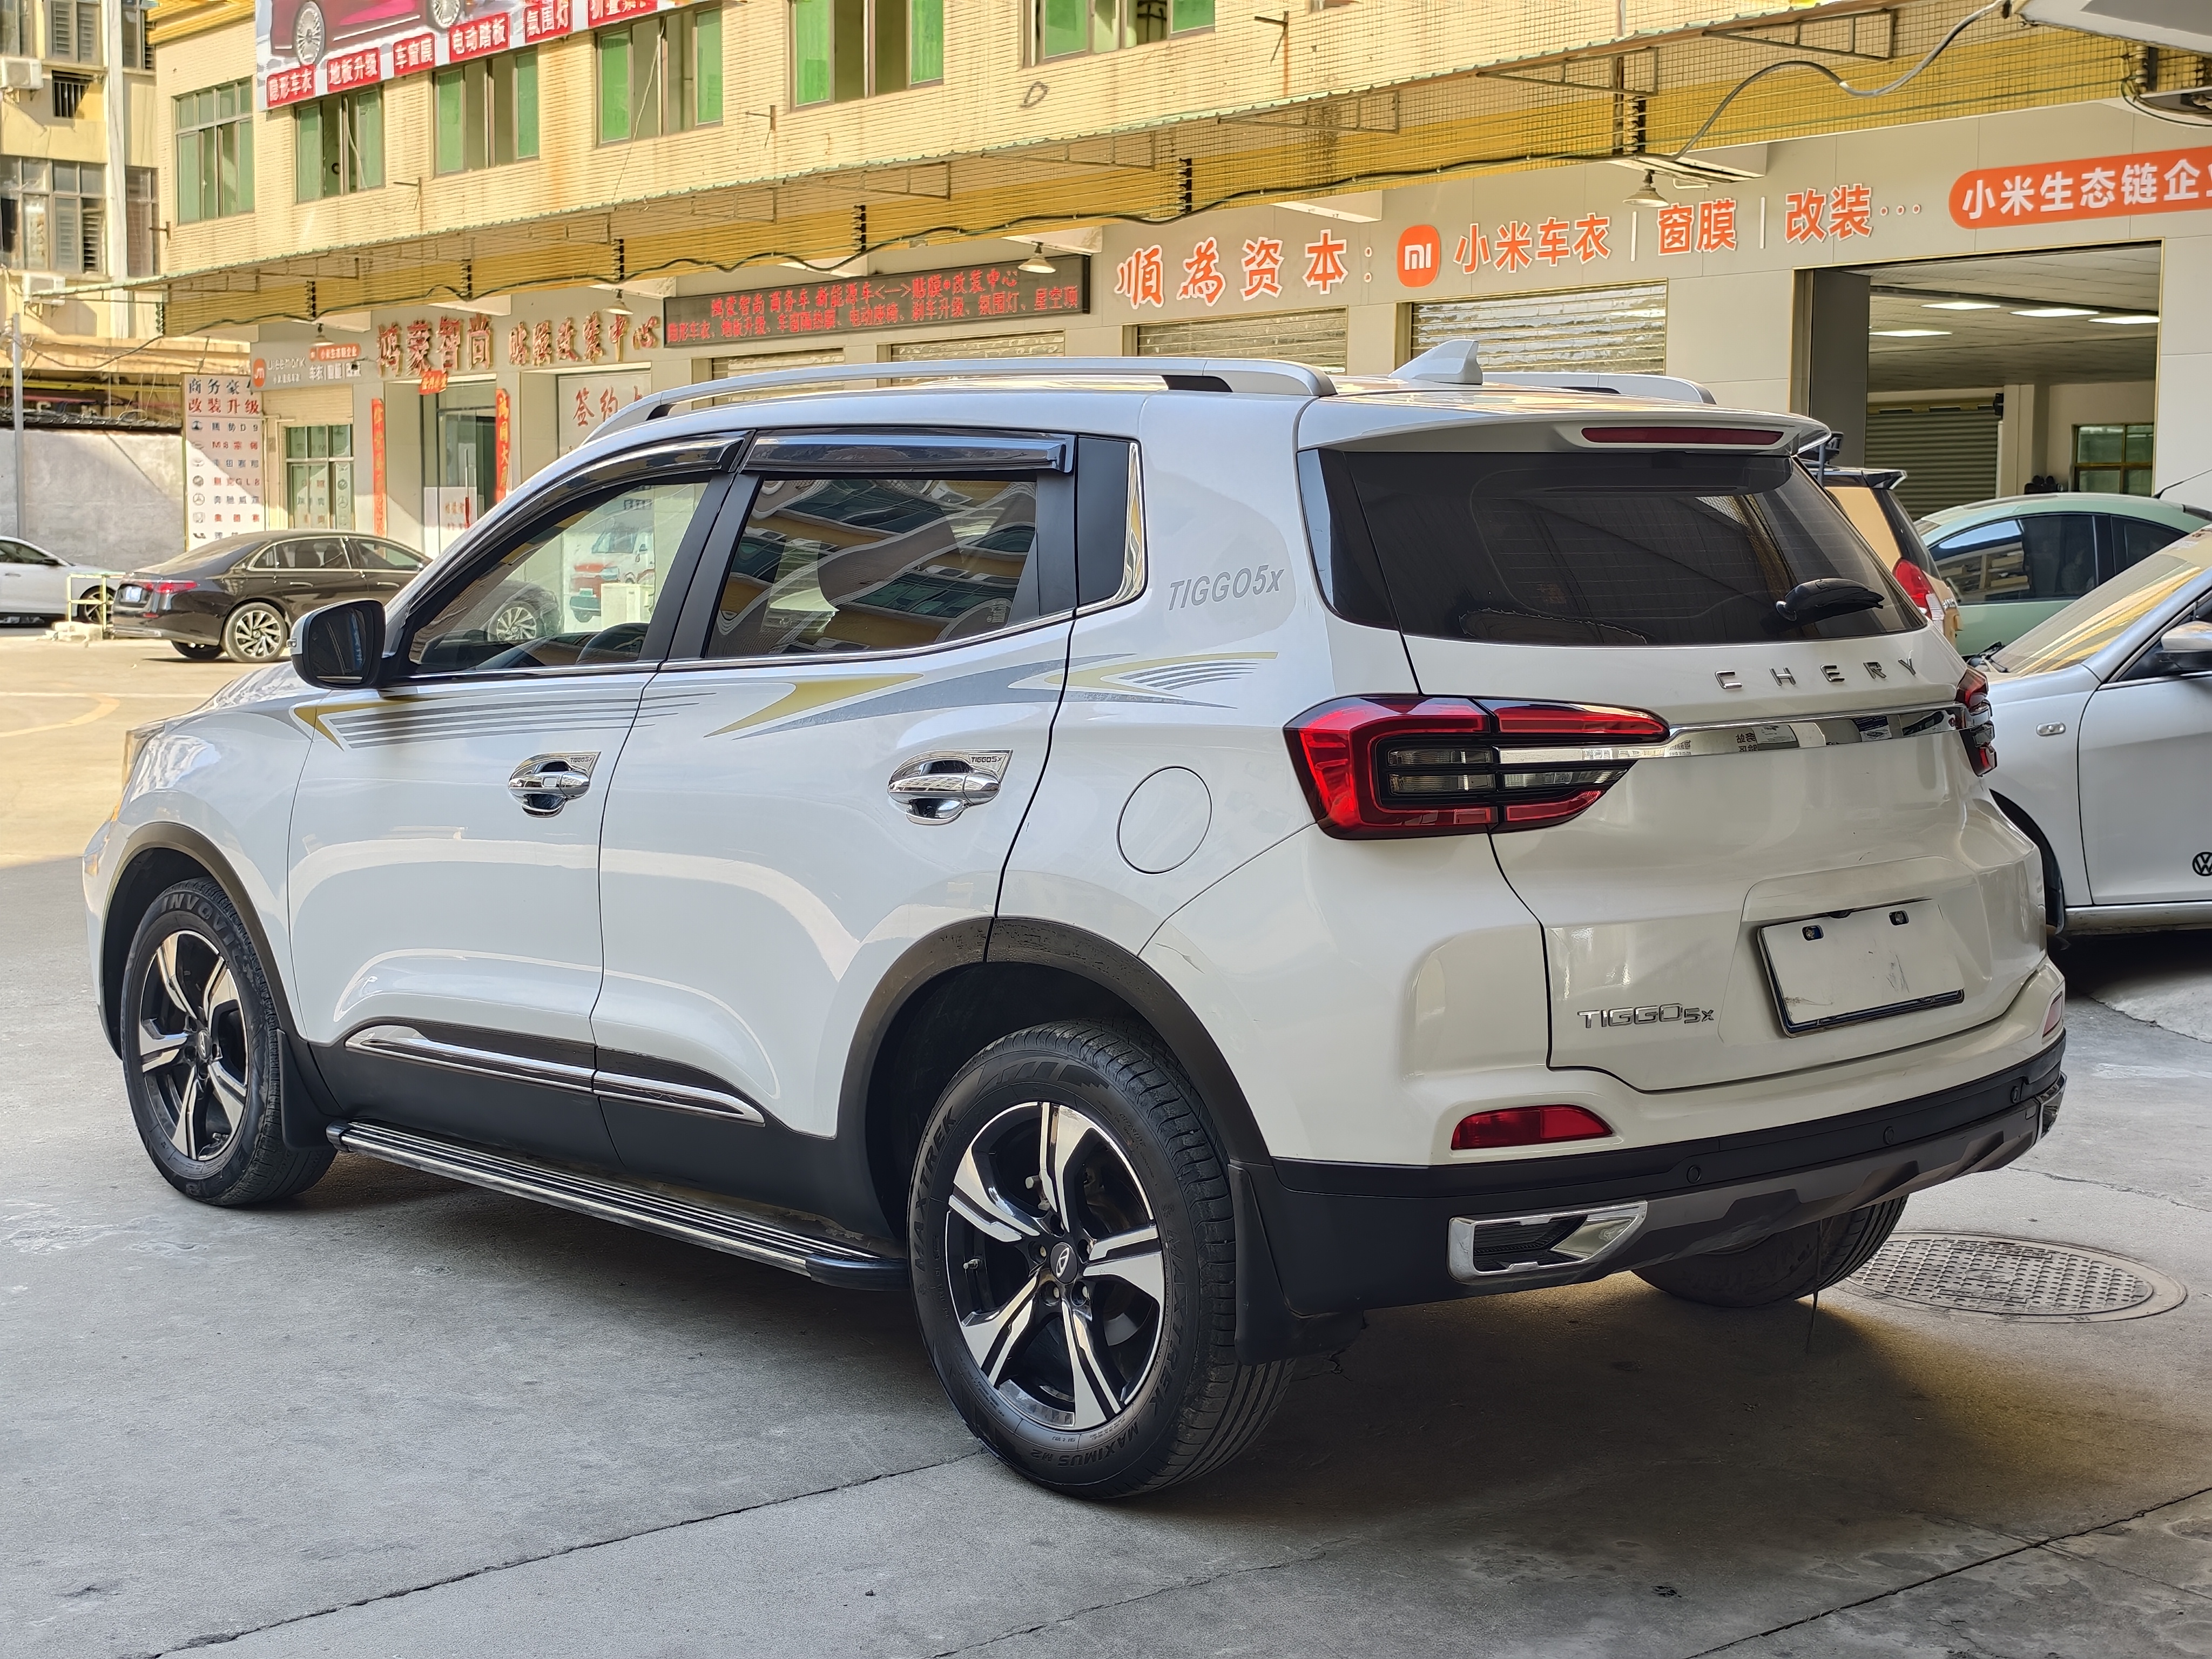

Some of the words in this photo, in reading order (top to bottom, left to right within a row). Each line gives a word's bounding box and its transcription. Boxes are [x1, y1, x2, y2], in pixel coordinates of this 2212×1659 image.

[1962, 158, 2212, 219] 小米生态链企
[1455, 213, 1611, 275] 小米车衣
[1658, 198, 1738, 256] 窗膜
[188, 398, 259, 415] 改装升级
[573, 385, 643, 426] 签约
[1714, 653, 1917, 690] CHERY
[913, 1104, 956, 1272] MAXTREK
[1057, 1421, 1139, 1467] MAXIMUS
